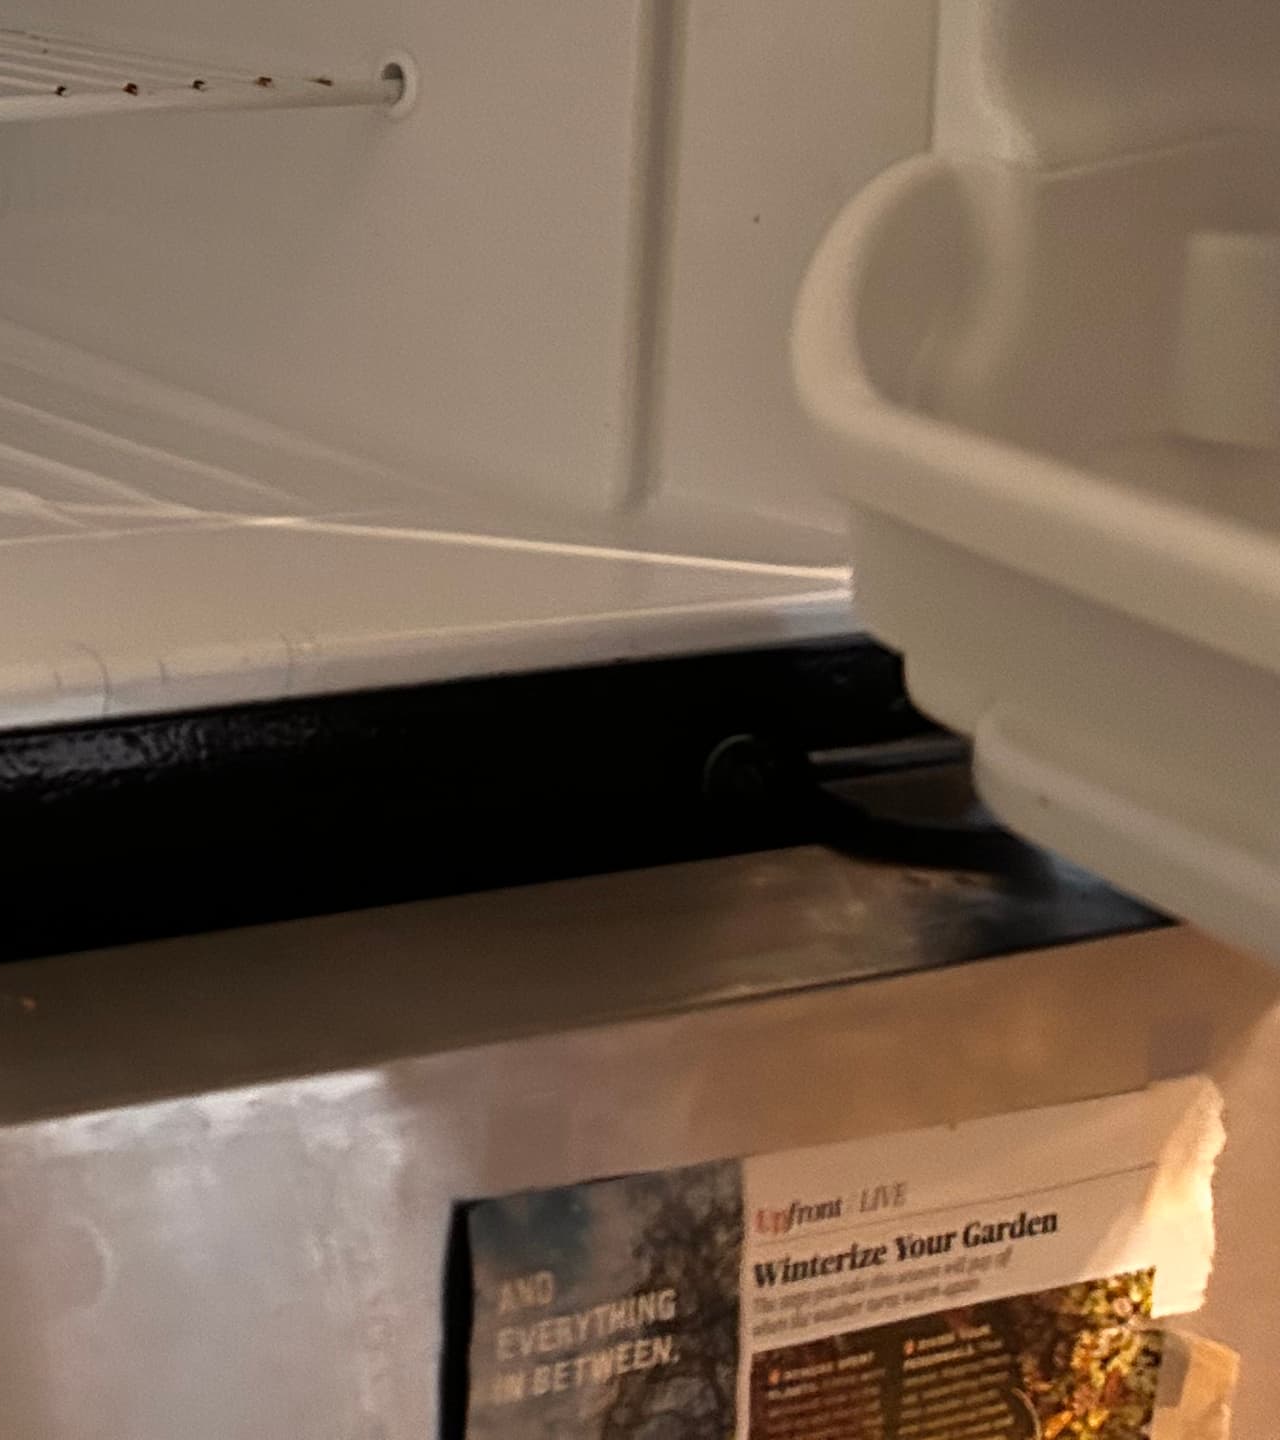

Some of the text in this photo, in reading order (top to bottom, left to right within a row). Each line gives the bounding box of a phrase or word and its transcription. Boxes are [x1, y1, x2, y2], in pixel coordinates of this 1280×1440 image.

[753, 1182, 907, 1235] Upfront LIVE
[754, 1212, 1058, 1288] Winterize Your Garden
[498, 1270, 554, 1313] AND
[497, 1289, 677, 1360] EVERYTHING
[495, 1370, 524, 1403] IN
